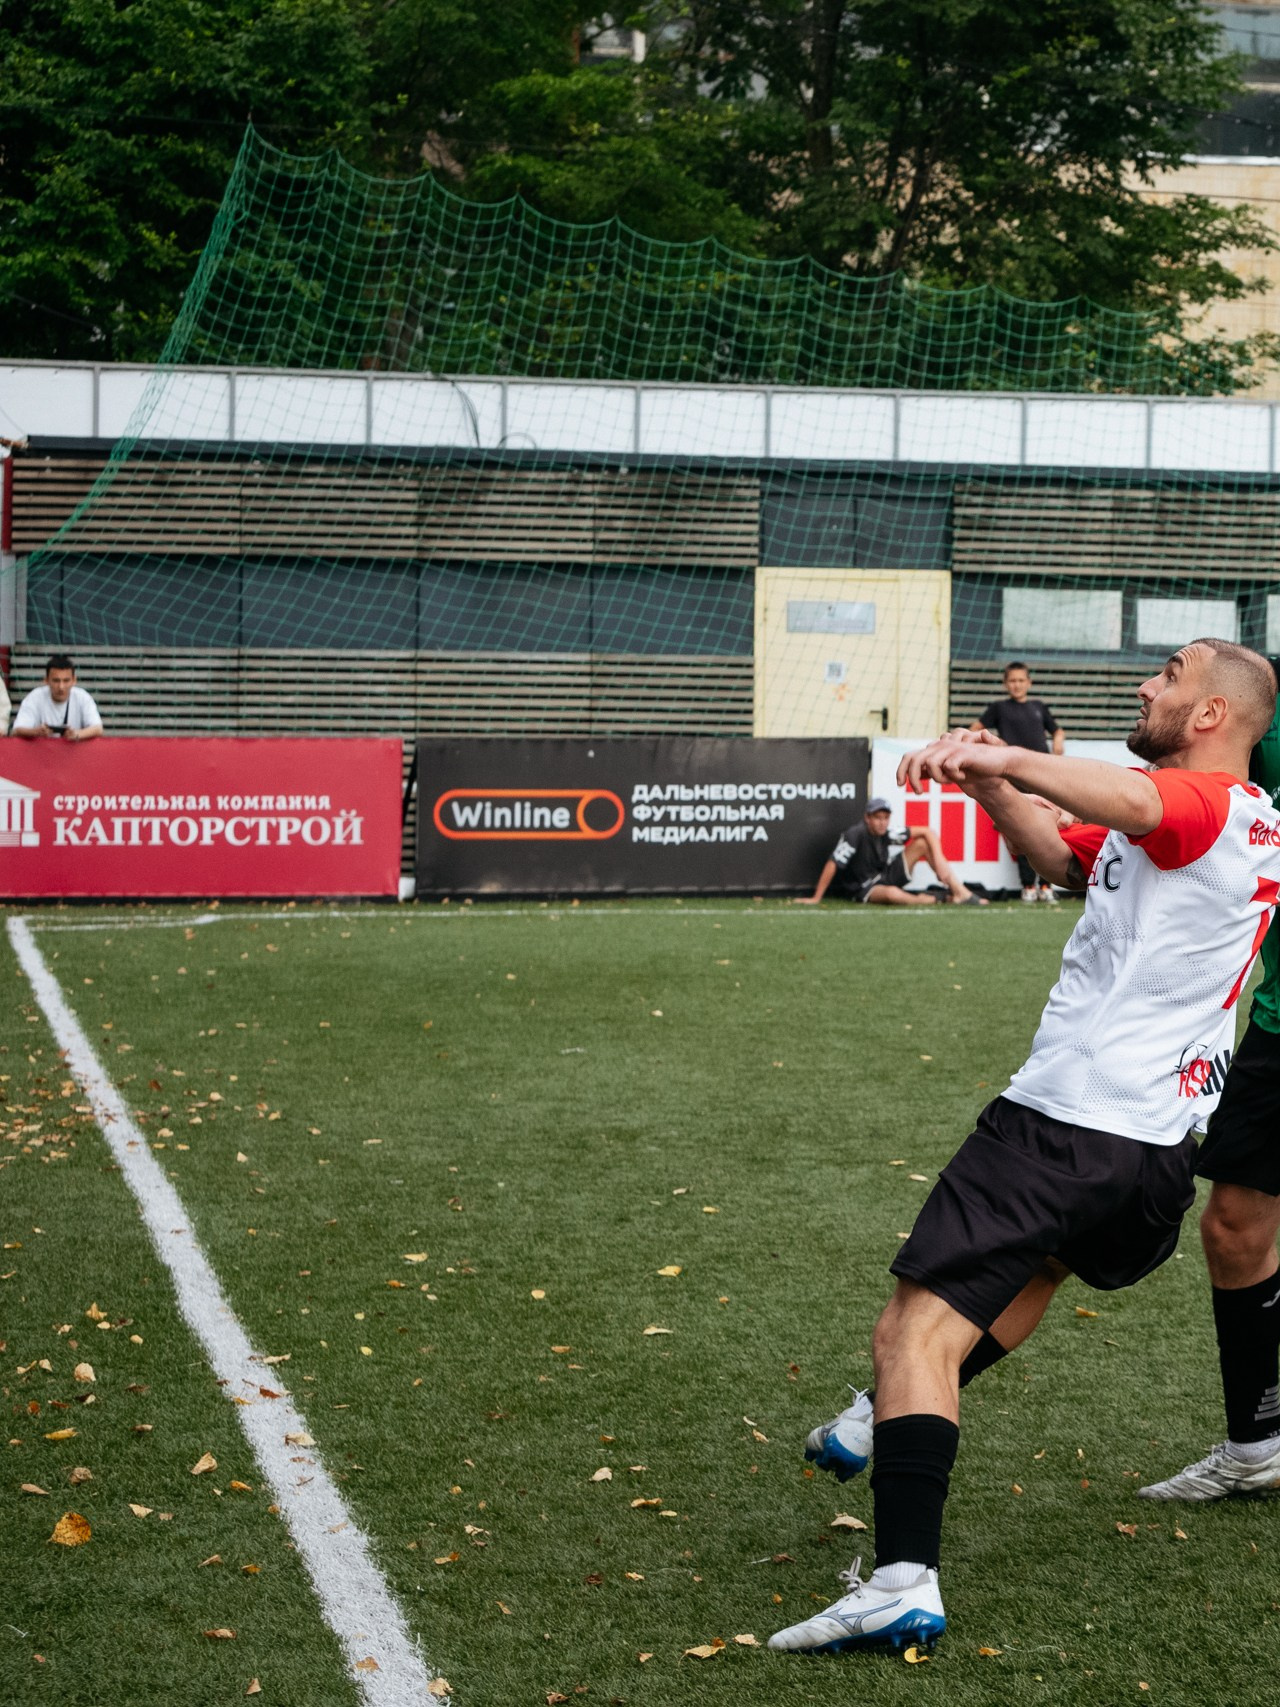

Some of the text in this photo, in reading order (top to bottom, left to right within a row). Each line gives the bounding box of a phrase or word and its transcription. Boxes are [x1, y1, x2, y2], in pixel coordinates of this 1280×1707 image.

[631, 783, 856, 802] ДАЛЬНЕВОСТОЧНАЯ
[53, 794, 331, 814] строительная компания
[632, 803, 785, 822] ФУТБОЛЬНАЯ
[451, 801, 571, 829] Winline
[53, 808, 364, 847] КАПТОРСТРОЙ
[631, 825, 769, 845] МЕДИАЛИГА
